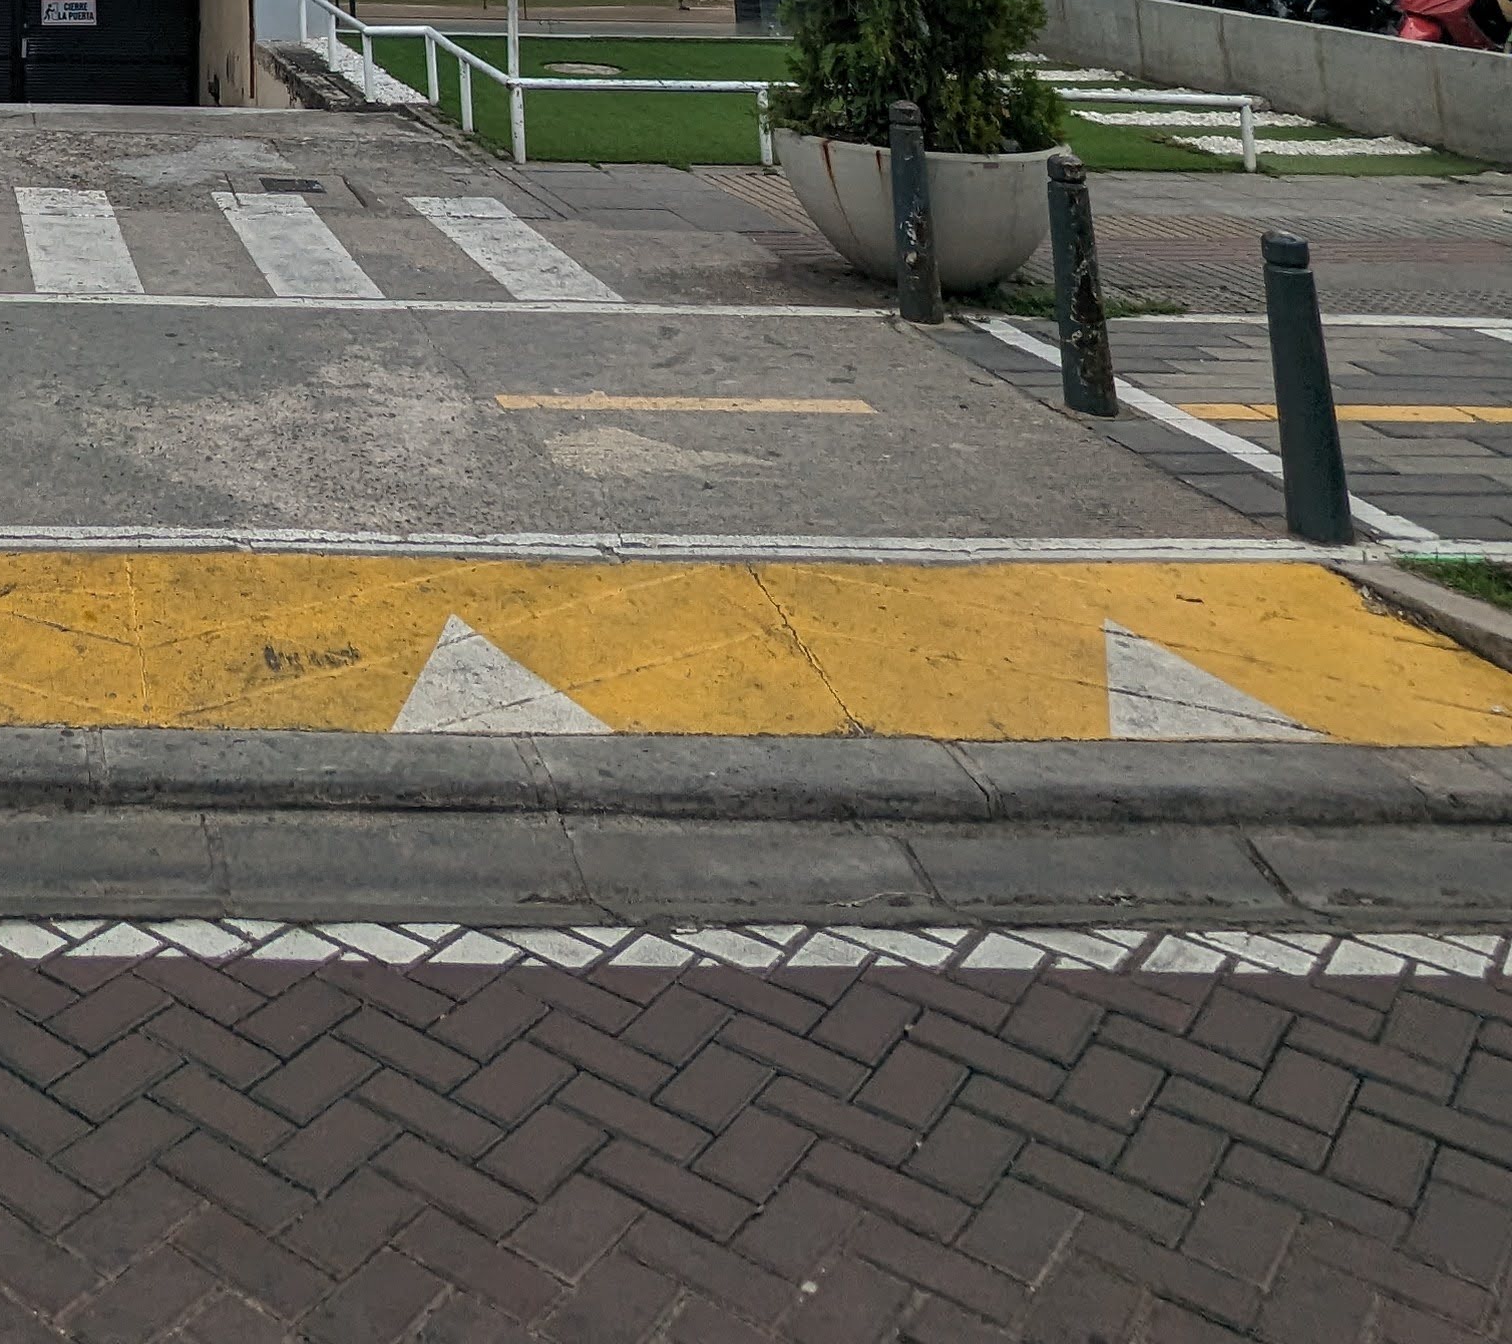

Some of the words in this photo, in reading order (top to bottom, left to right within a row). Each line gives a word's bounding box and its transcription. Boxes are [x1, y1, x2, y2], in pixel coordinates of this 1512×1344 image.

[63, 2, 88, 12] CIERRE
[58, 11, 67, 21] LA
[68, 11, 95, 21] PUERTA
